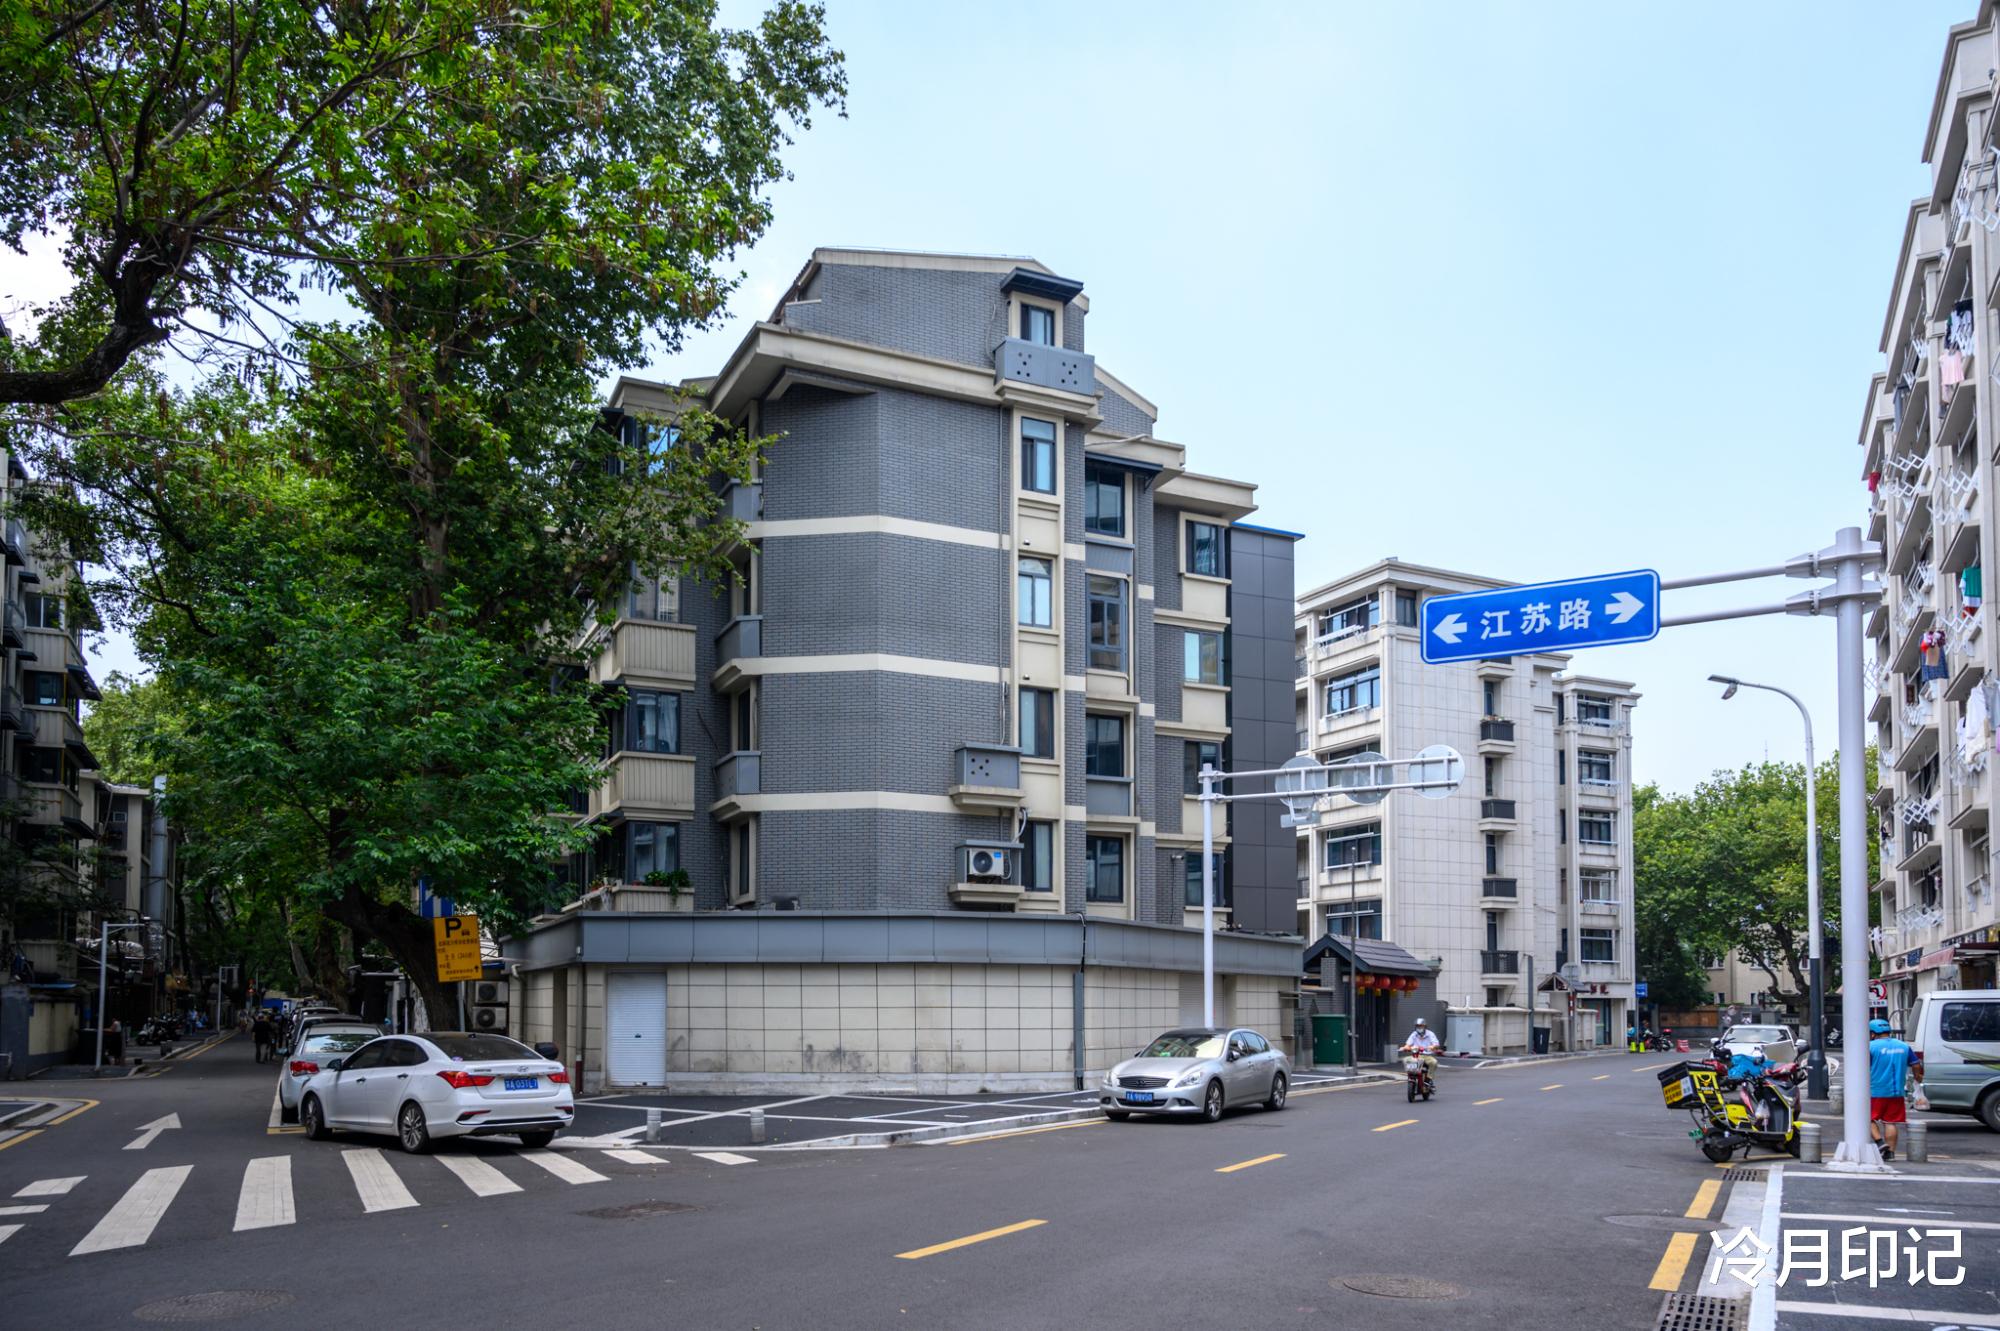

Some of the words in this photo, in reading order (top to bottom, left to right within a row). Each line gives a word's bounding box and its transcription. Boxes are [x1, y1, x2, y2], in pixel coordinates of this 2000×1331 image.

[1480, 598, 1593, 641] 江苏路
[445, 918, 462, 938] P
